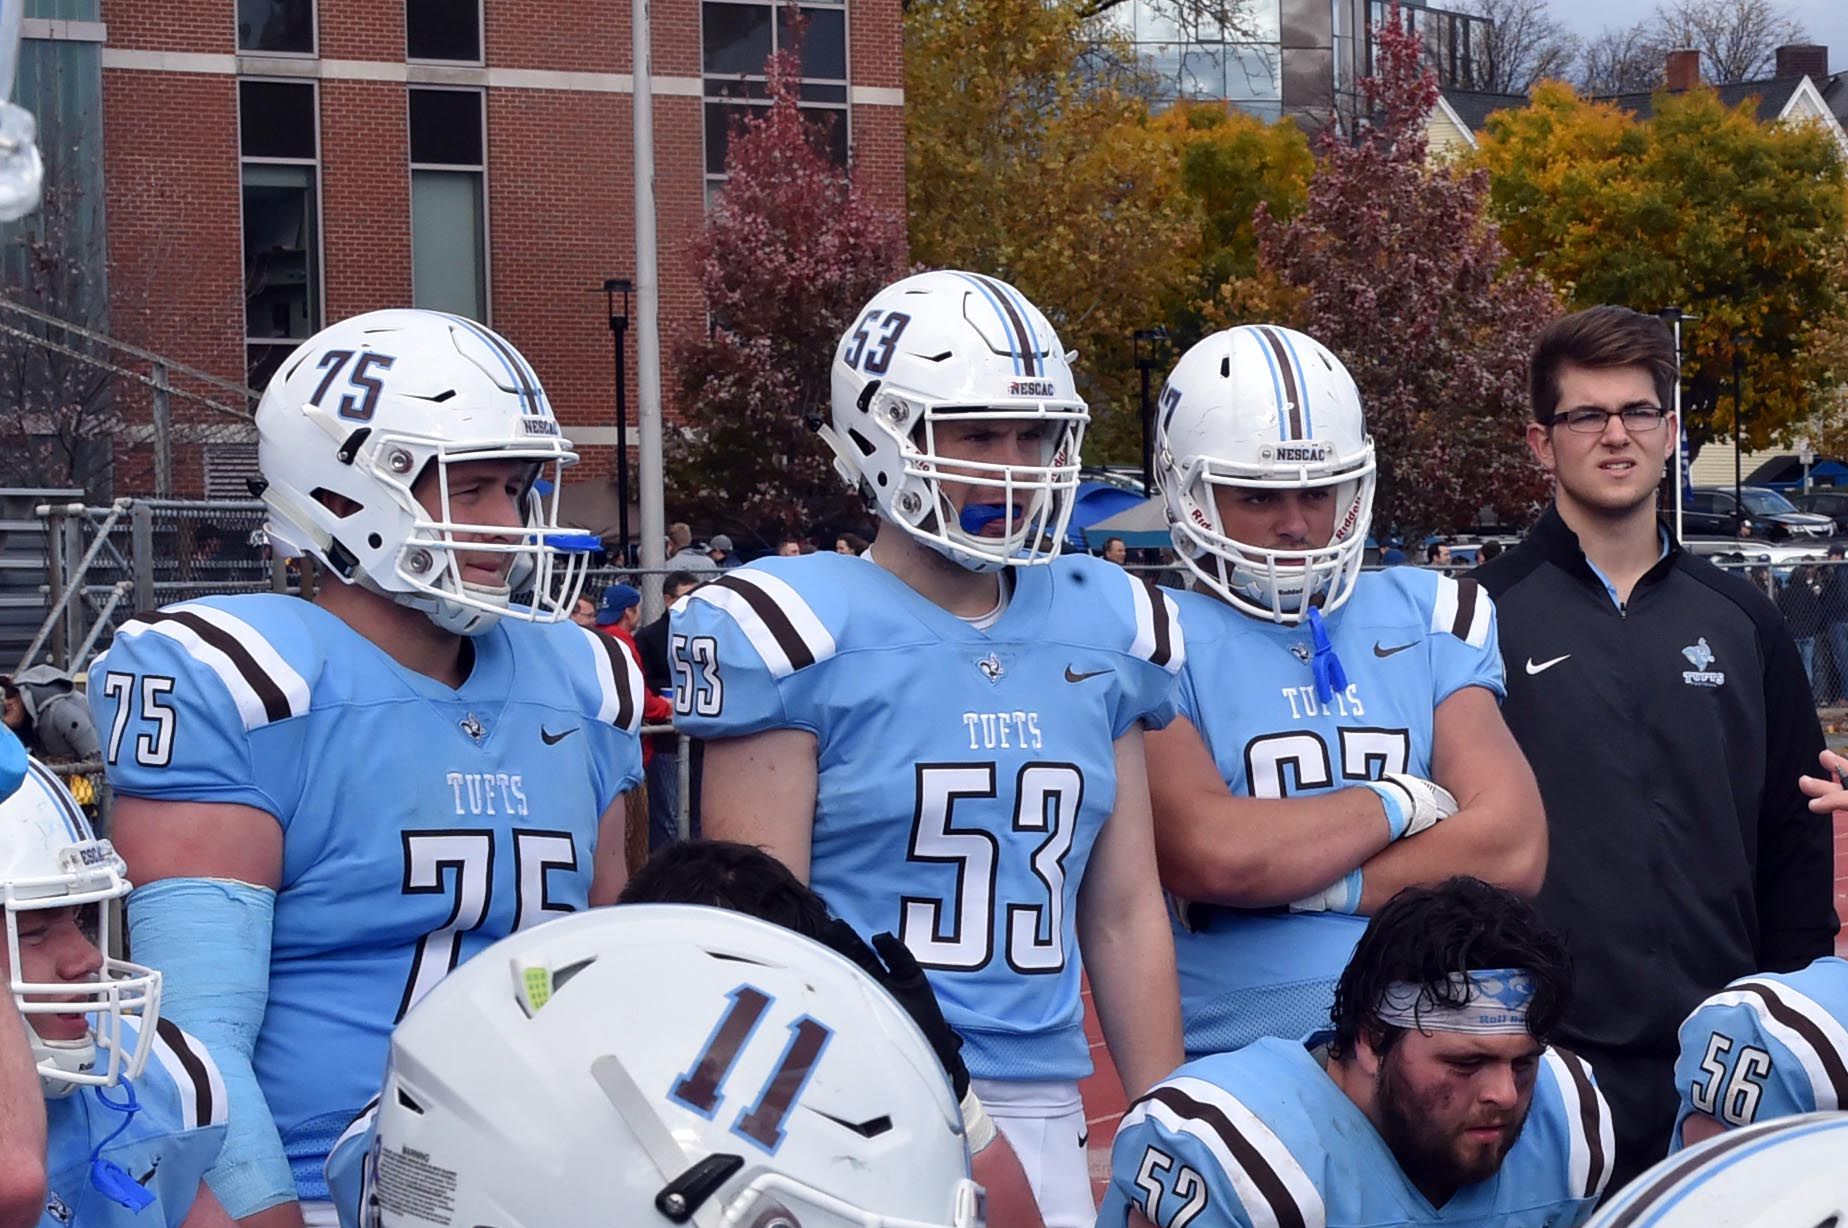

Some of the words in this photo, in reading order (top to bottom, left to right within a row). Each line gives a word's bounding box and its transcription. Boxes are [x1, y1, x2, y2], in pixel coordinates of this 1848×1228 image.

[844, 309, 912, 377] 53
[309, 349, 398, 424] 75
[1011, 380, 1054, 397] NESCAC
[1276, 448, 1326, 462] NESCAC
[672, 634, 723, 718] 53
[103, 671, 176, 768] 75
[963, 711, 1042, 749] TUFTS
[446, 772, 529, 816] TUFTS
[900, 761, 1085, 975] 53
[667, 983, 835, 1157] 11
[1691, 1031, 1773, 1128] 56
